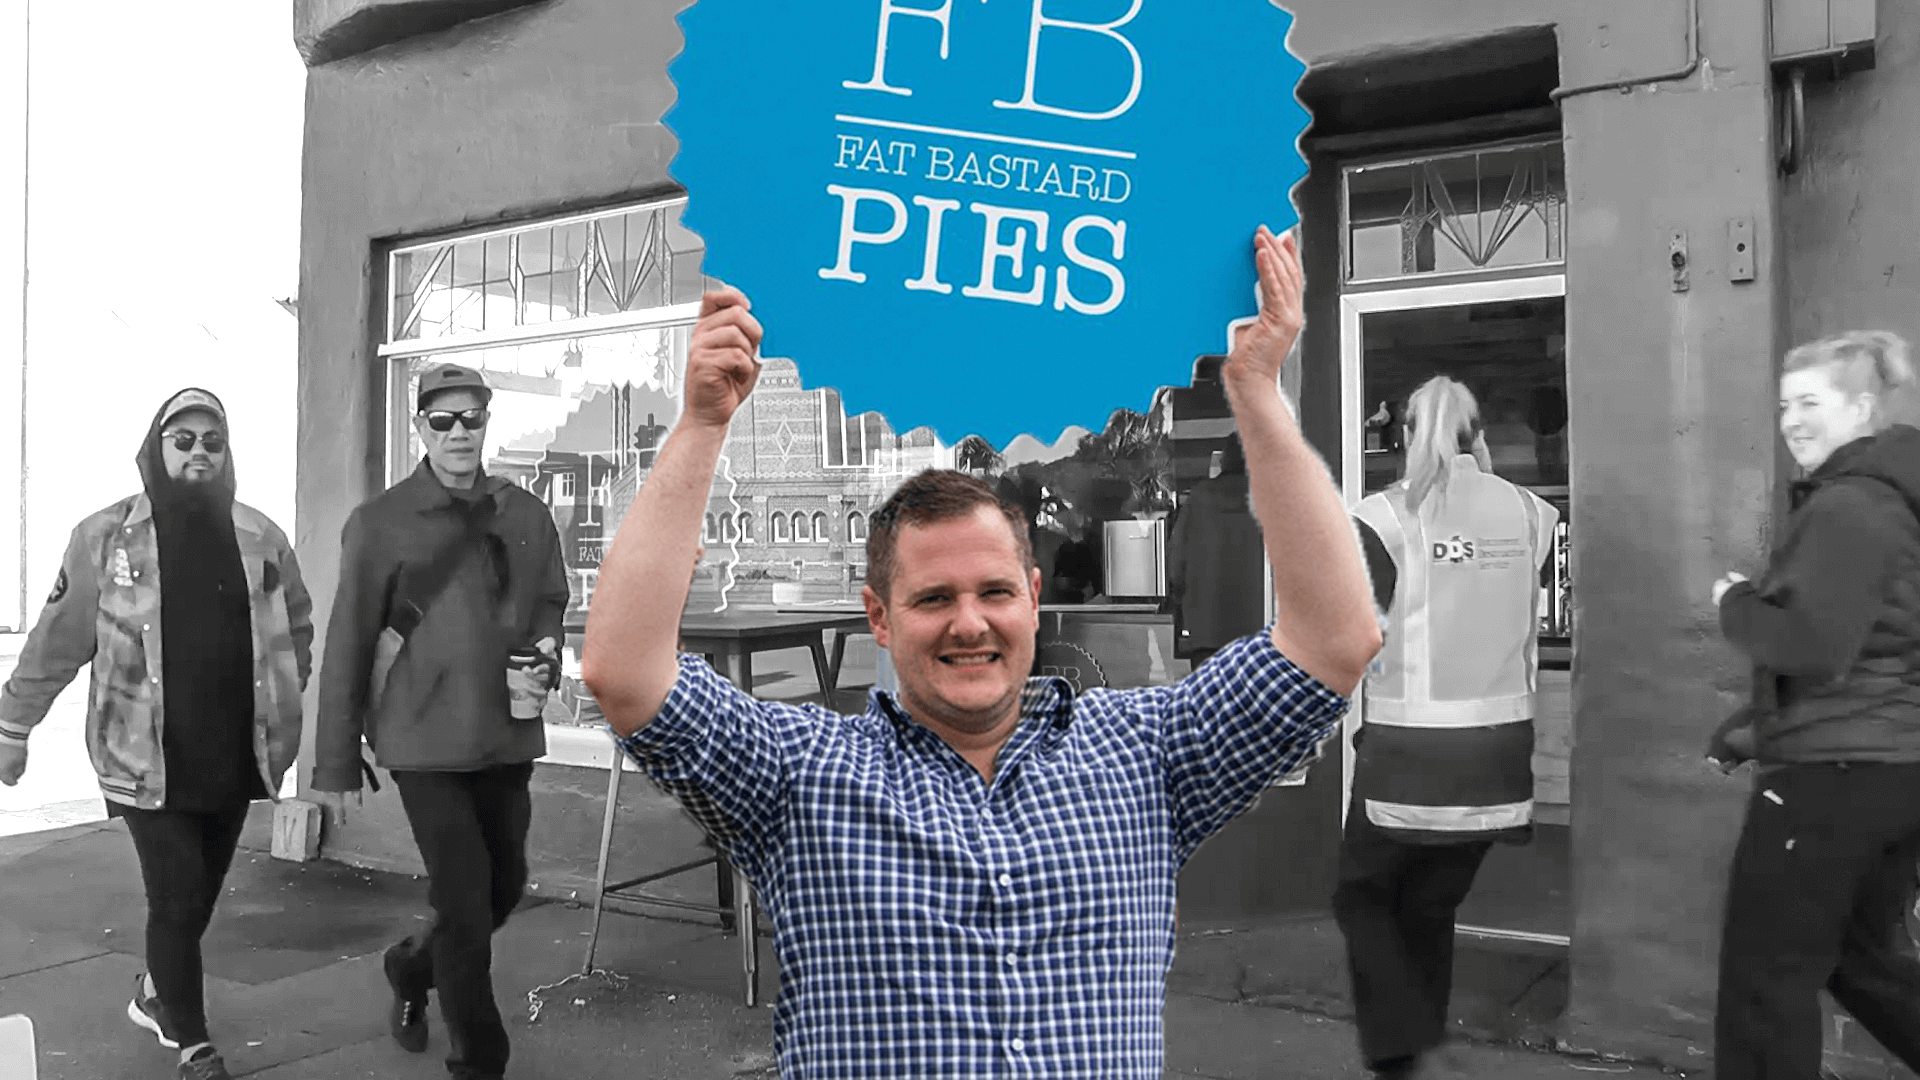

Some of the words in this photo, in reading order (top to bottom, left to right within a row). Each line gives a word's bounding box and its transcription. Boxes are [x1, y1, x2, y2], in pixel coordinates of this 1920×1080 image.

[834, 134, 916, 177] FAT
[926, 146, 1132, 204] BASTARD
[818, 183, 1127, 316] PIES
